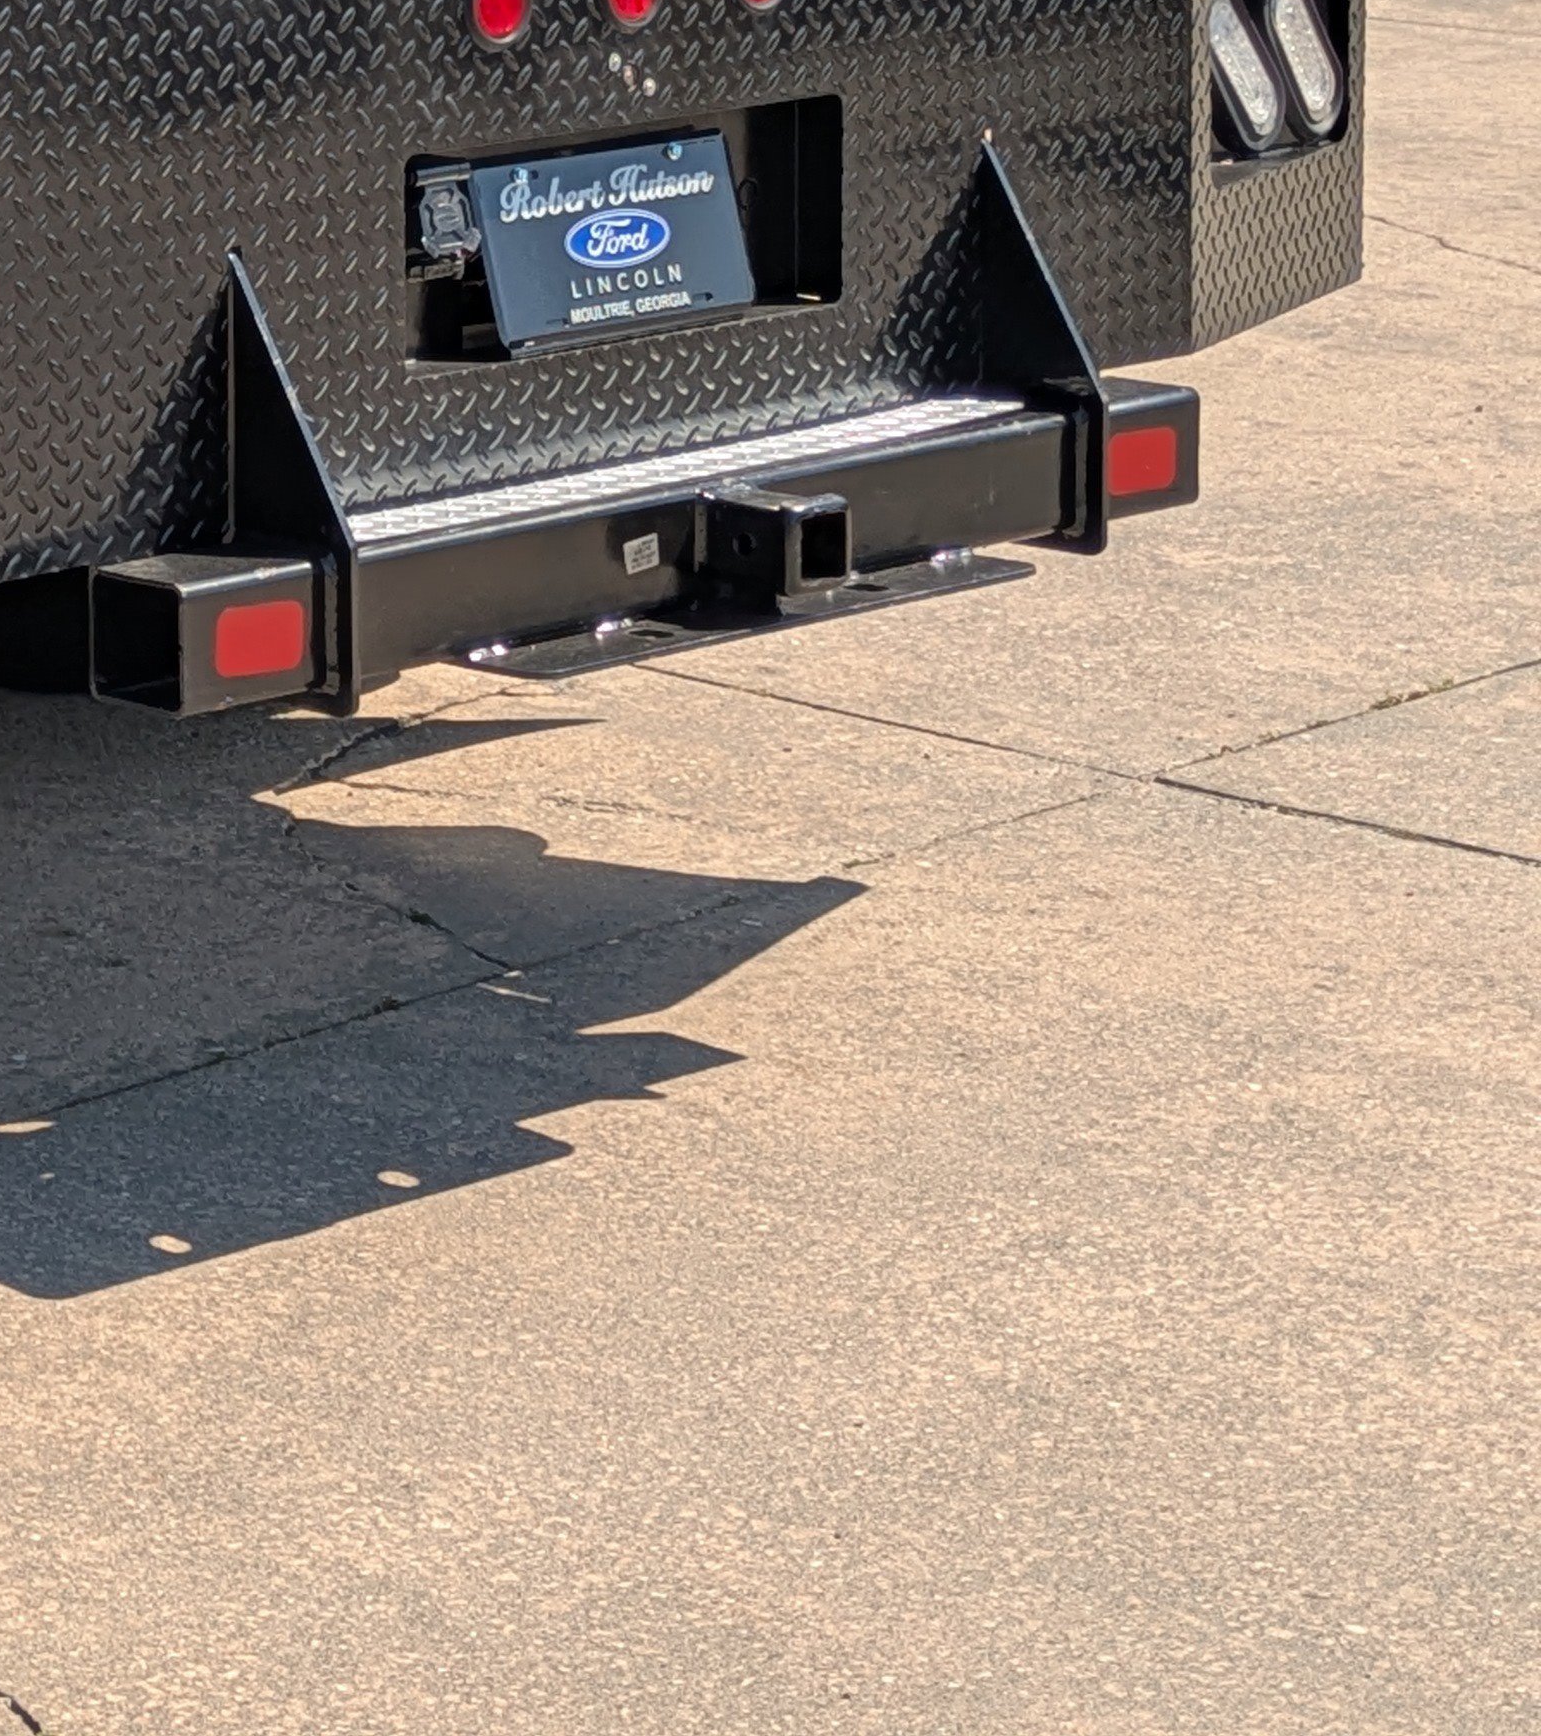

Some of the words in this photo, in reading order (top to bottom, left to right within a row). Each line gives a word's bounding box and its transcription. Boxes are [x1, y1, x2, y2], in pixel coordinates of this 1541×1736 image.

[499, 178, 605, 224] Robert
[608, 163, 715, 206] Hutson
[586, 217, 649, 257] Ford
[570, 262, 683, 300] LINCOLN
[570, 299, 635, 325] MOULTRIE,
[636, 290, 692, 314] GEORGIA
